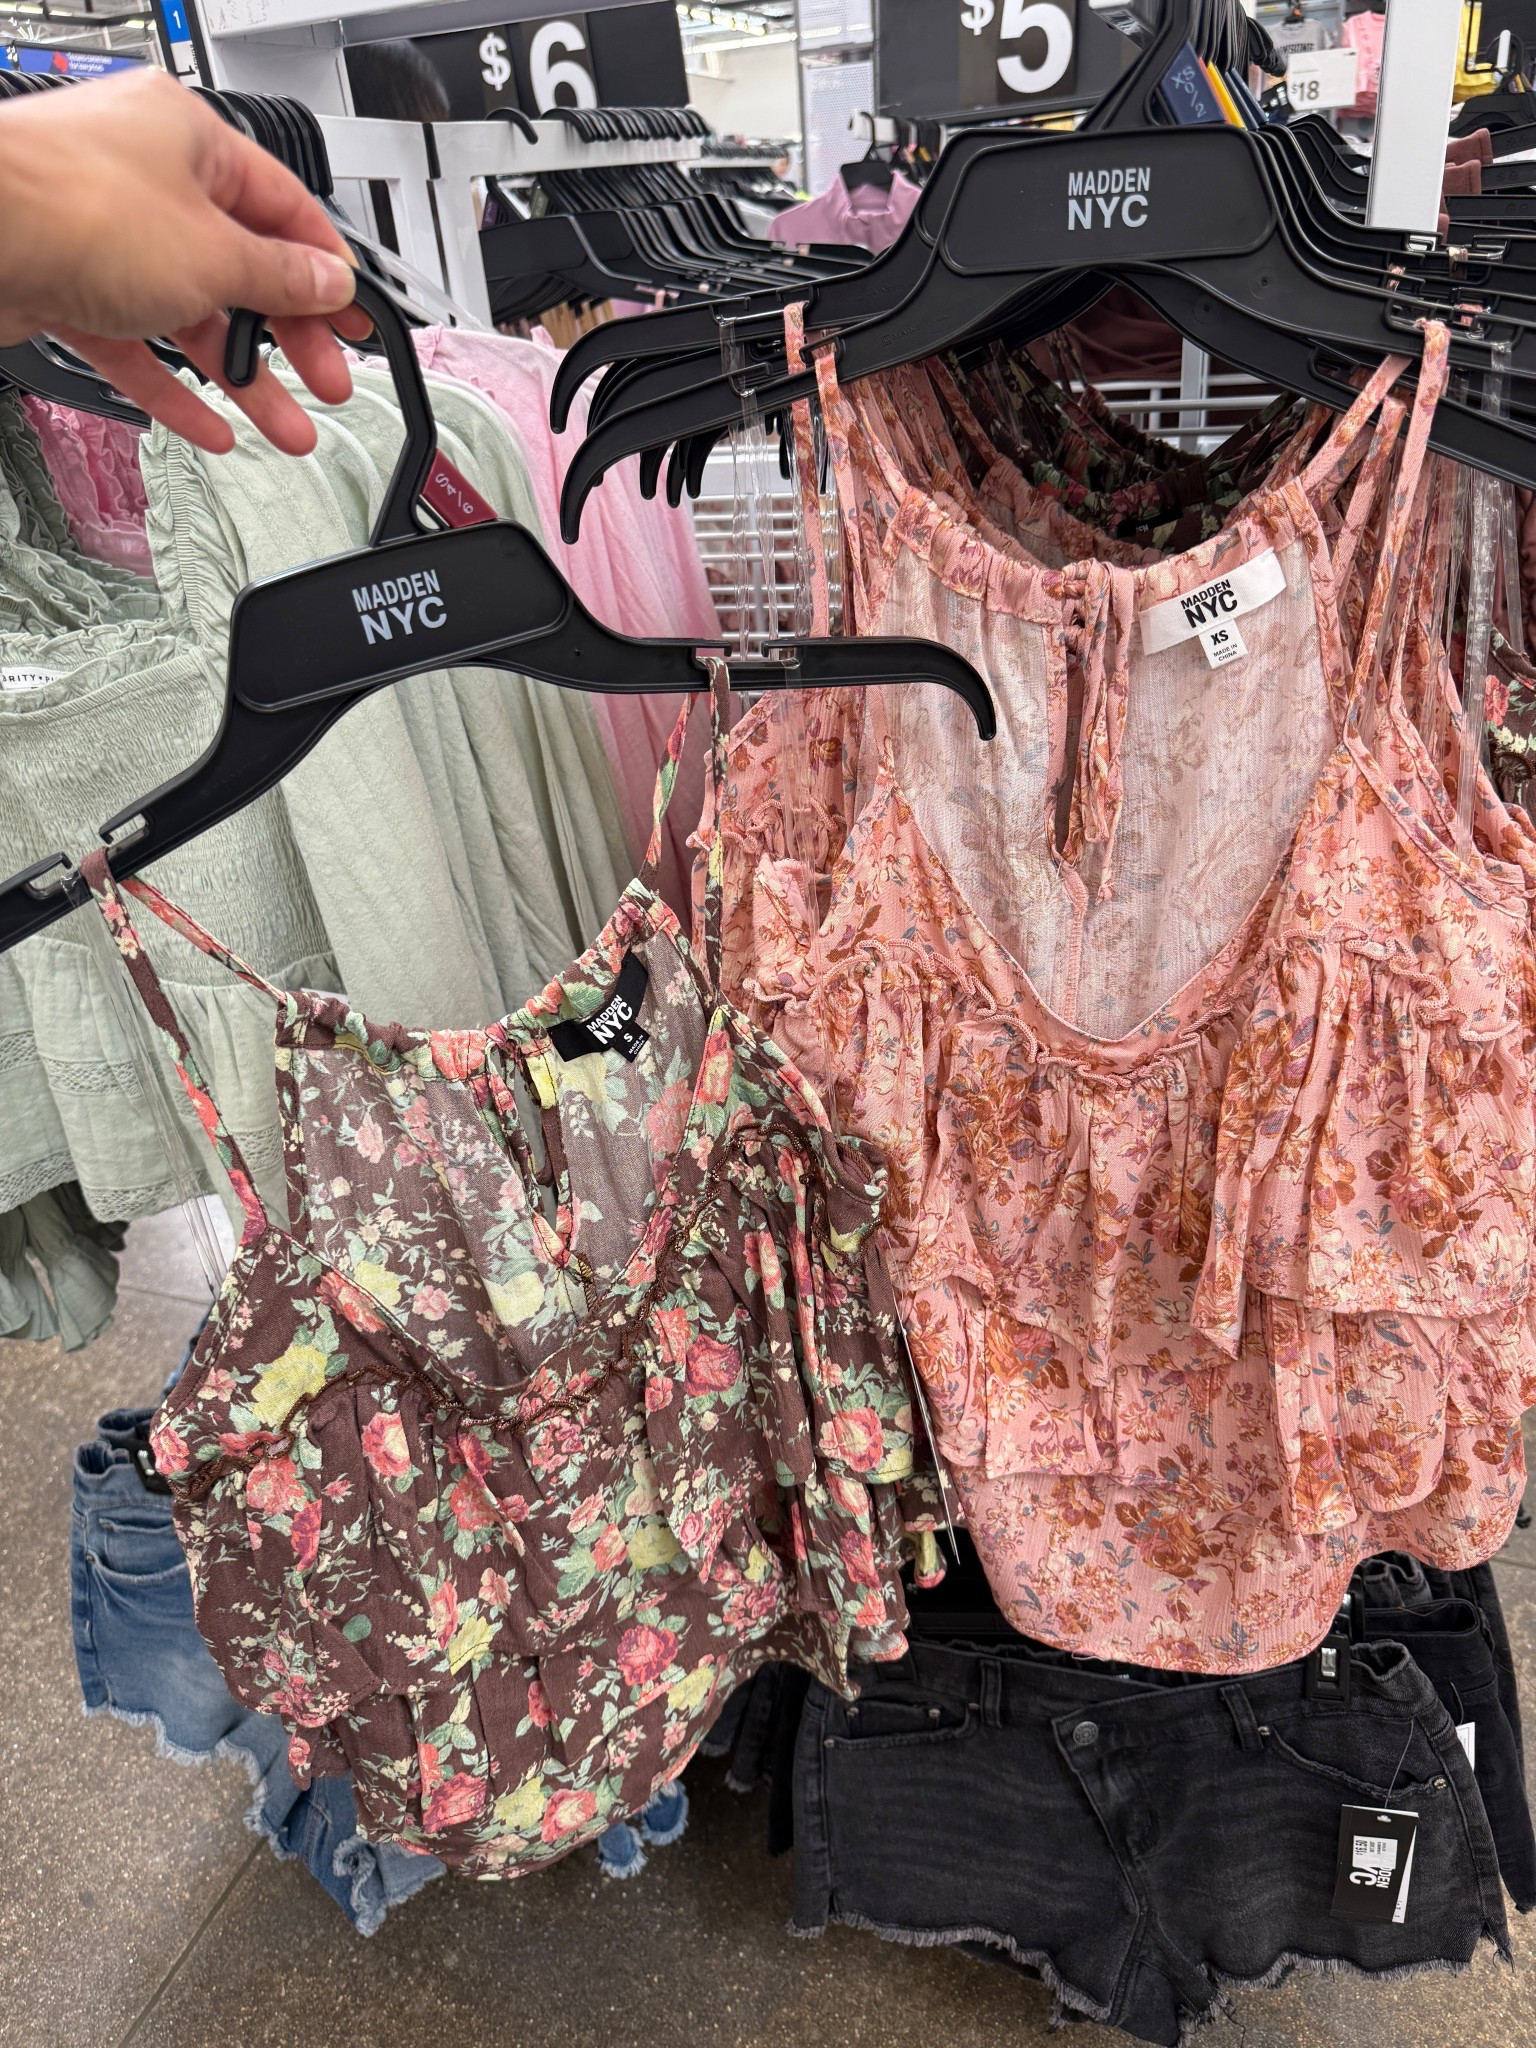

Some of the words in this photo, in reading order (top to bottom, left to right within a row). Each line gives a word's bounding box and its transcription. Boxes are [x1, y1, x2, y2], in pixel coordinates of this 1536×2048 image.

[173, 10, 181, 29] 1
[1291, 80, 1320, 102] $18
[1068, 167, 1151, 196] MADDEN
[1068, 194, 1149, 230] NYC
[352, 569, 441, 613] MADDEN
[1180, 579, 1231, 610] MADDEN
[360, 596, 447, 645] NYC
[1184, 590, 1238, 629] NYC
[1210, 630, 1229, 646] XS
[1213, 646, 1231, 657] MADE
[1218, 650, 1238, 662] CHINA
[586, 994, 623, 1032] MADDEN
[593, 1001, 633, 1045] NYC
[623, 1032, 633, 1043] S
